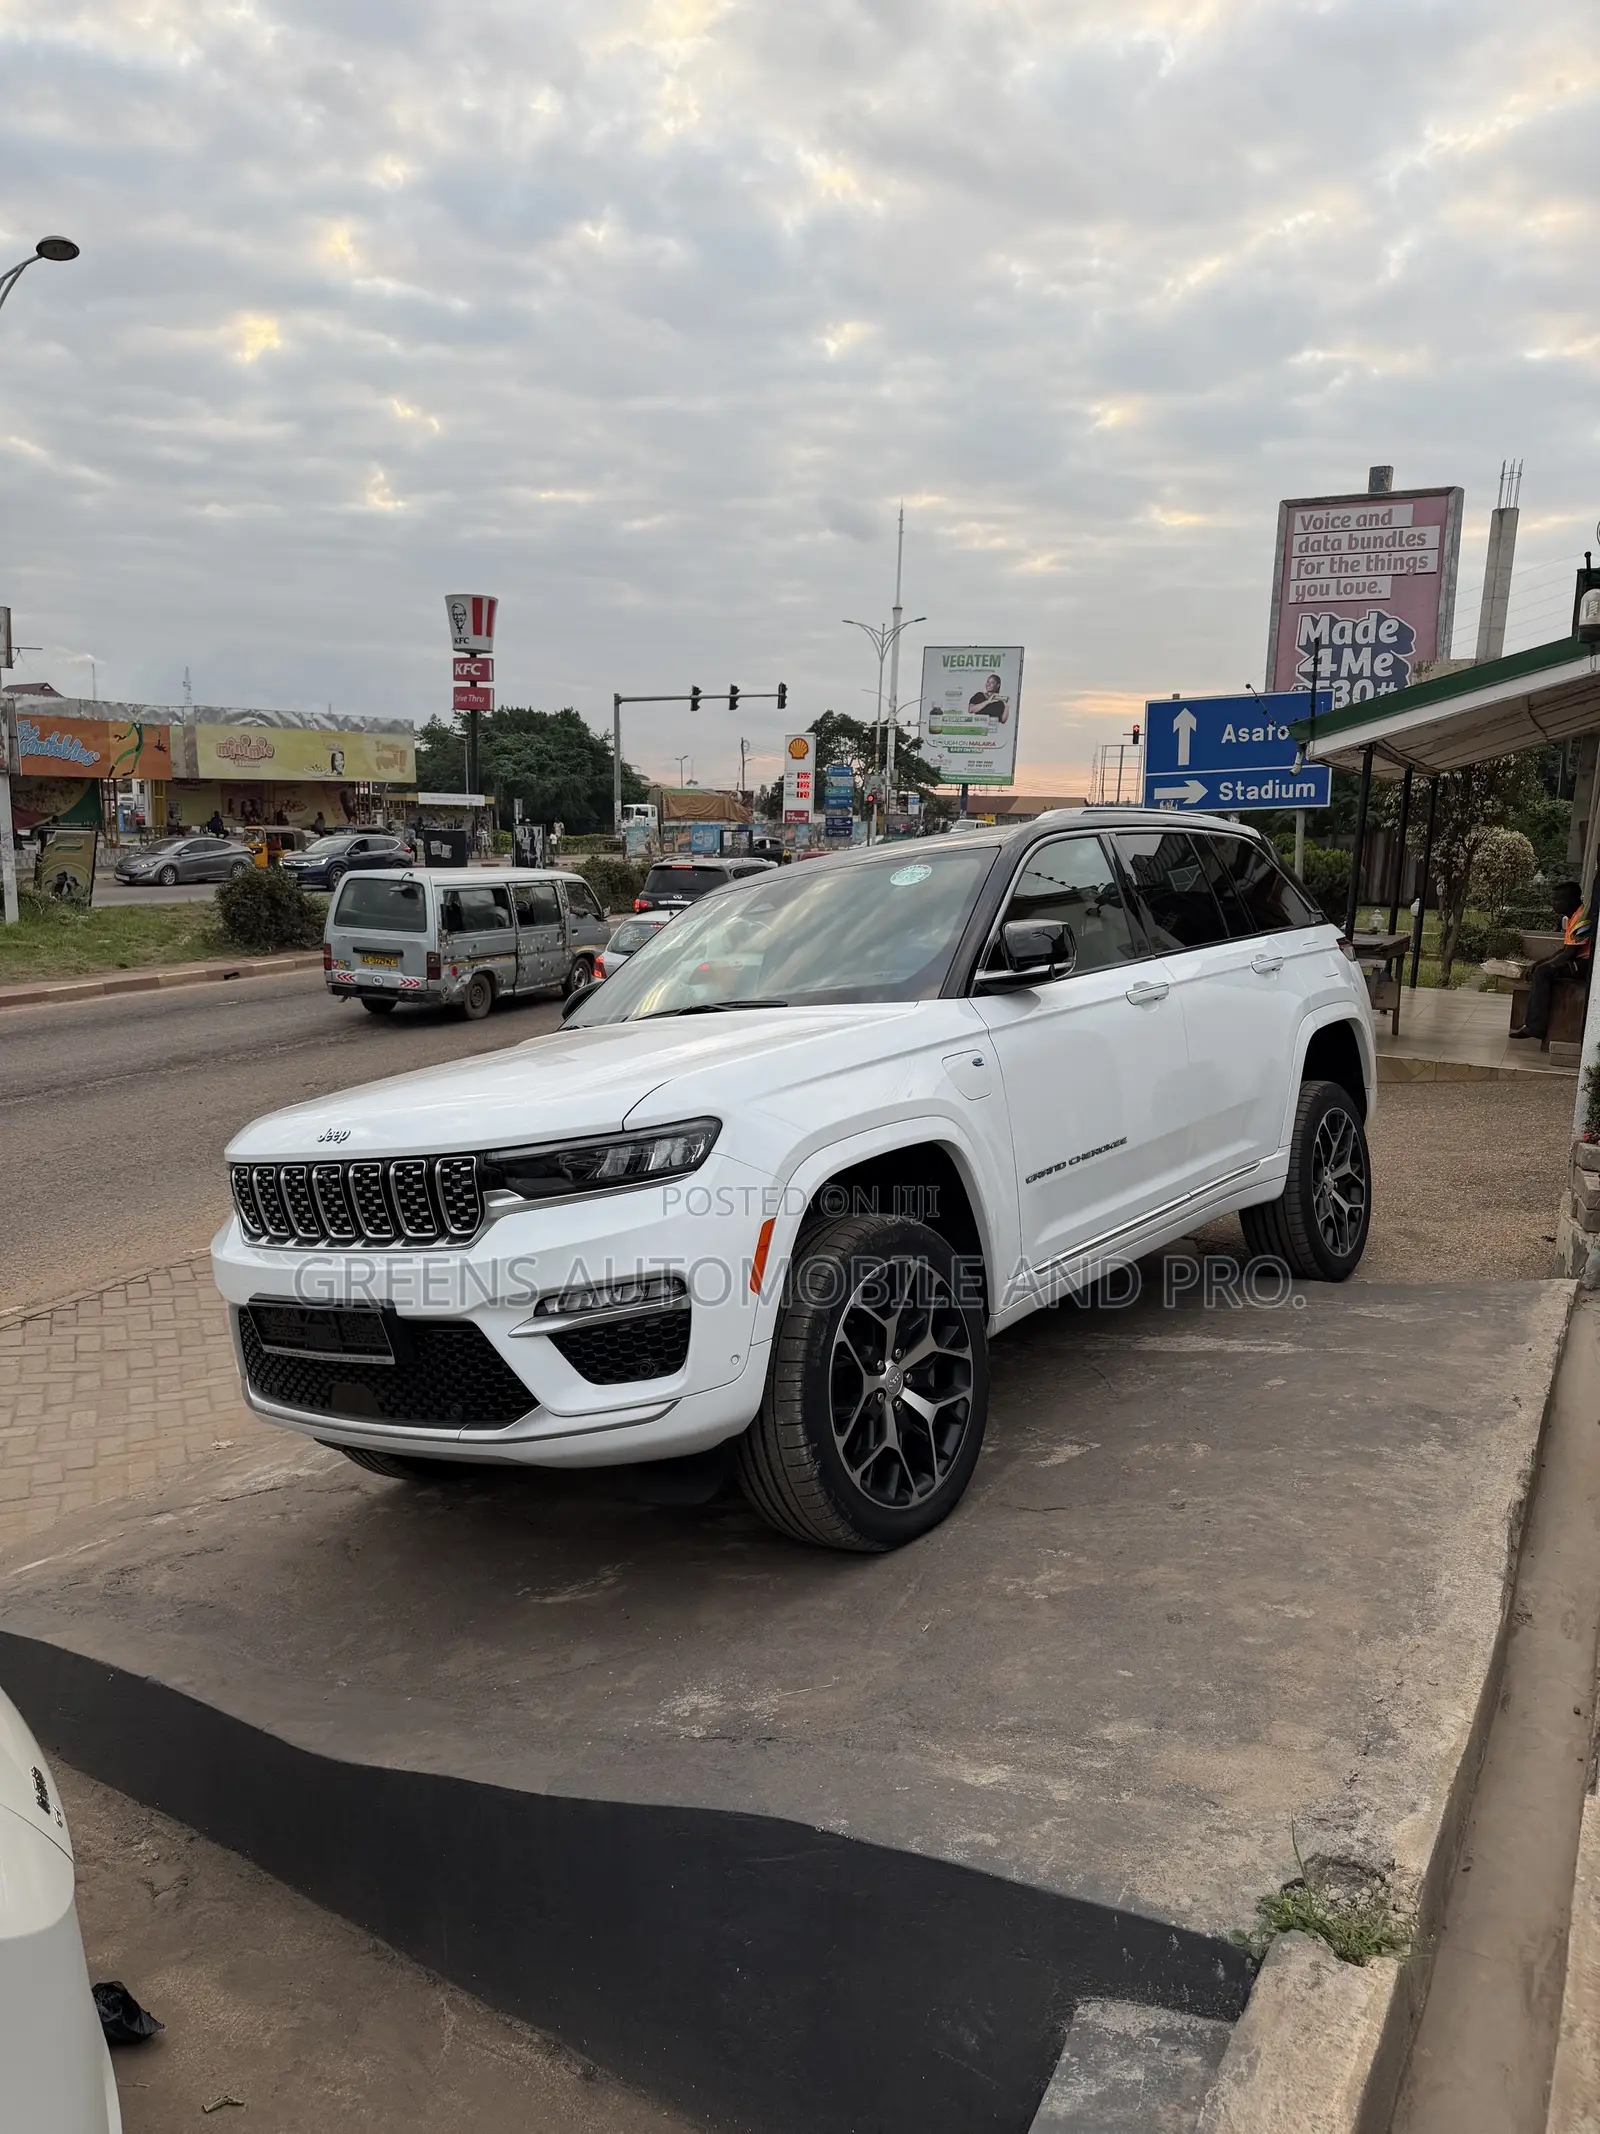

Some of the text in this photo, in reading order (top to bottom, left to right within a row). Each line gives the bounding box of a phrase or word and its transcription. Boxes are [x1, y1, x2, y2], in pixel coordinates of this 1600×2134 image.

[1300, 508, 1393, 531] Voice and
[1298, 530, 1427, 554] data bundles
[1296, 552, 1429, 579] for the things
[1295, 579, 1383, 601] you love.
[1300, 611, 1400, 646] Made
[455, 663, 483, 676] KFC
[1298, 647, 1394, 678] 4 Me
[468, 694, 485, 703] Thru
[1221, 723, 1289, 744] Asafo
[1219, 779, 1315, 801] Stadium
[316, 1127, 352, 1144] Jeep
[1025, 1136, 1128, 1184] GRAND CHEROKEE
